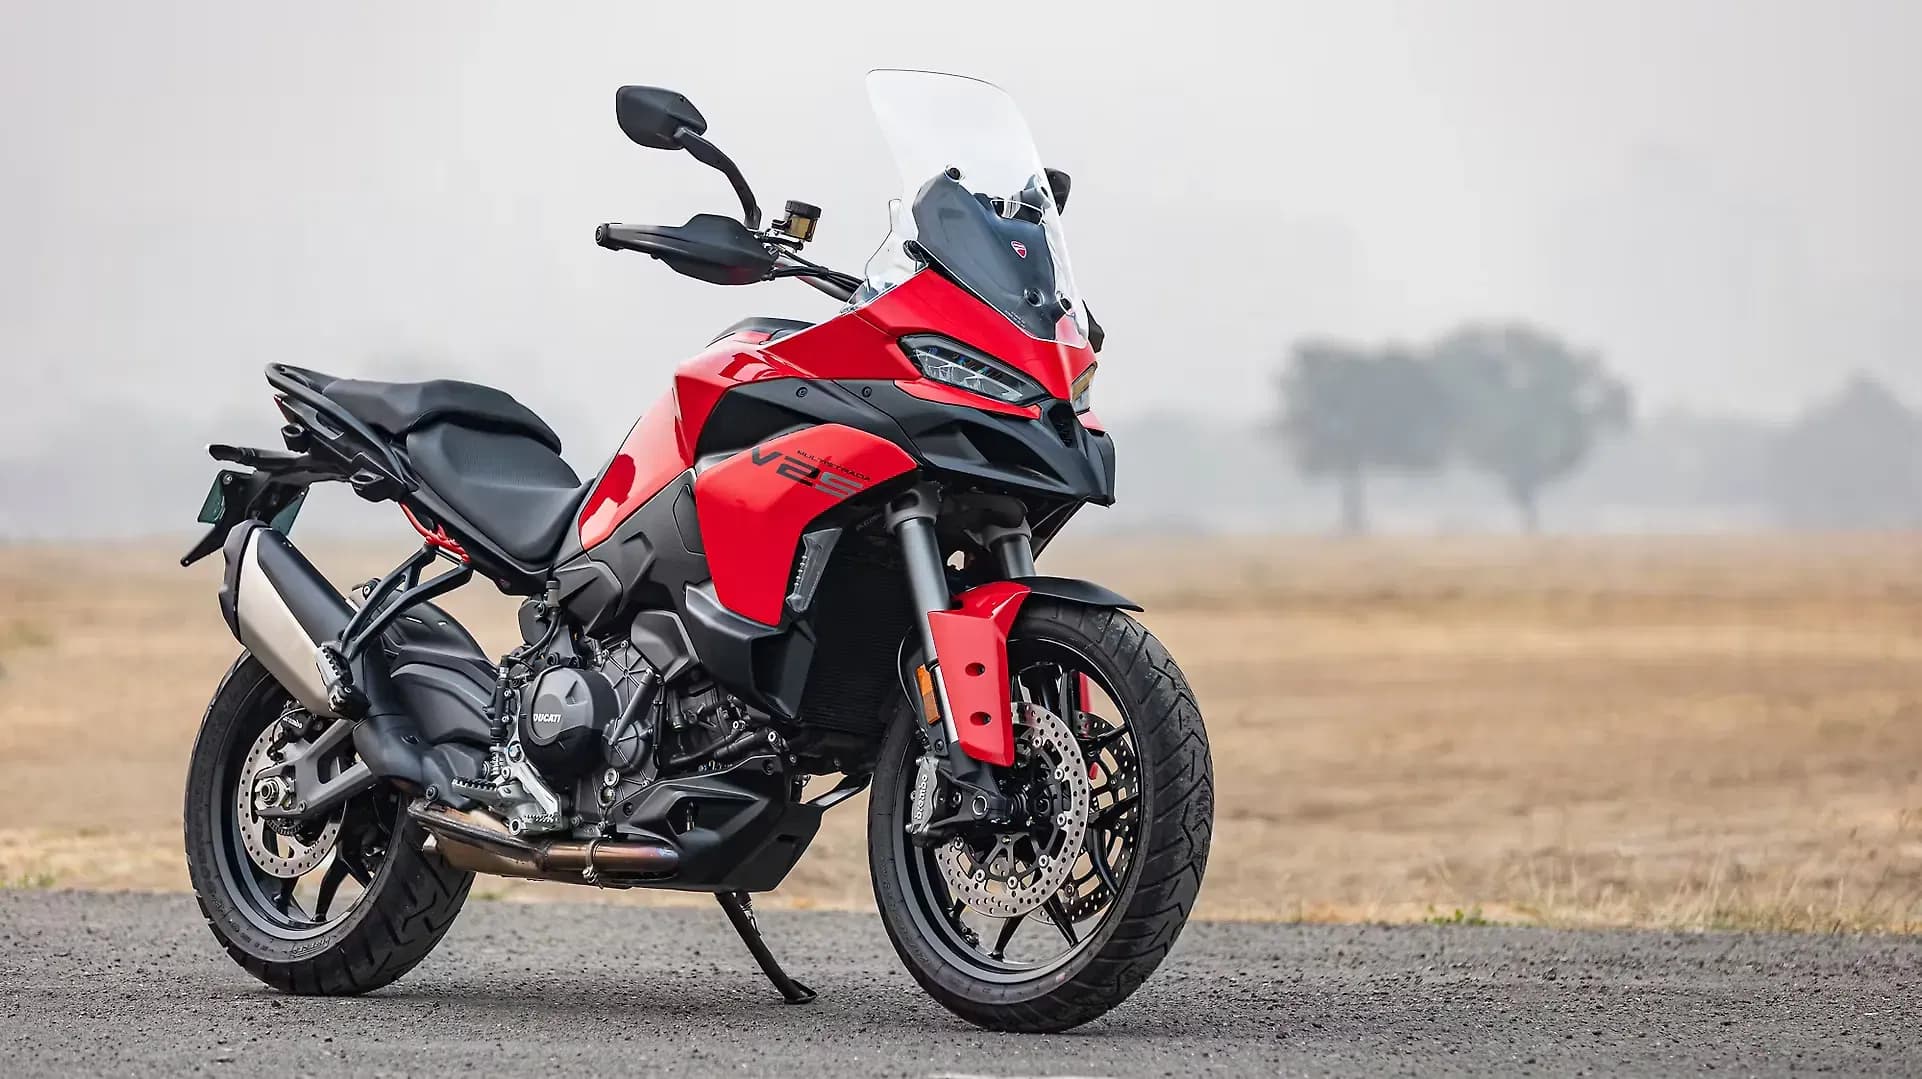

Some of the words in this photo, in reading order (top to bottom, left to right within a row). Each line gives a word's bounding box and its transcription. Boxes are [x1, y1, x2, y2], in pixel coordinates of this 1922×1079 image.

[752, 447, 863, 499] V2S
[533, 713, 561, 723] DUCATI
[914, 774, 928, 820] brembo
